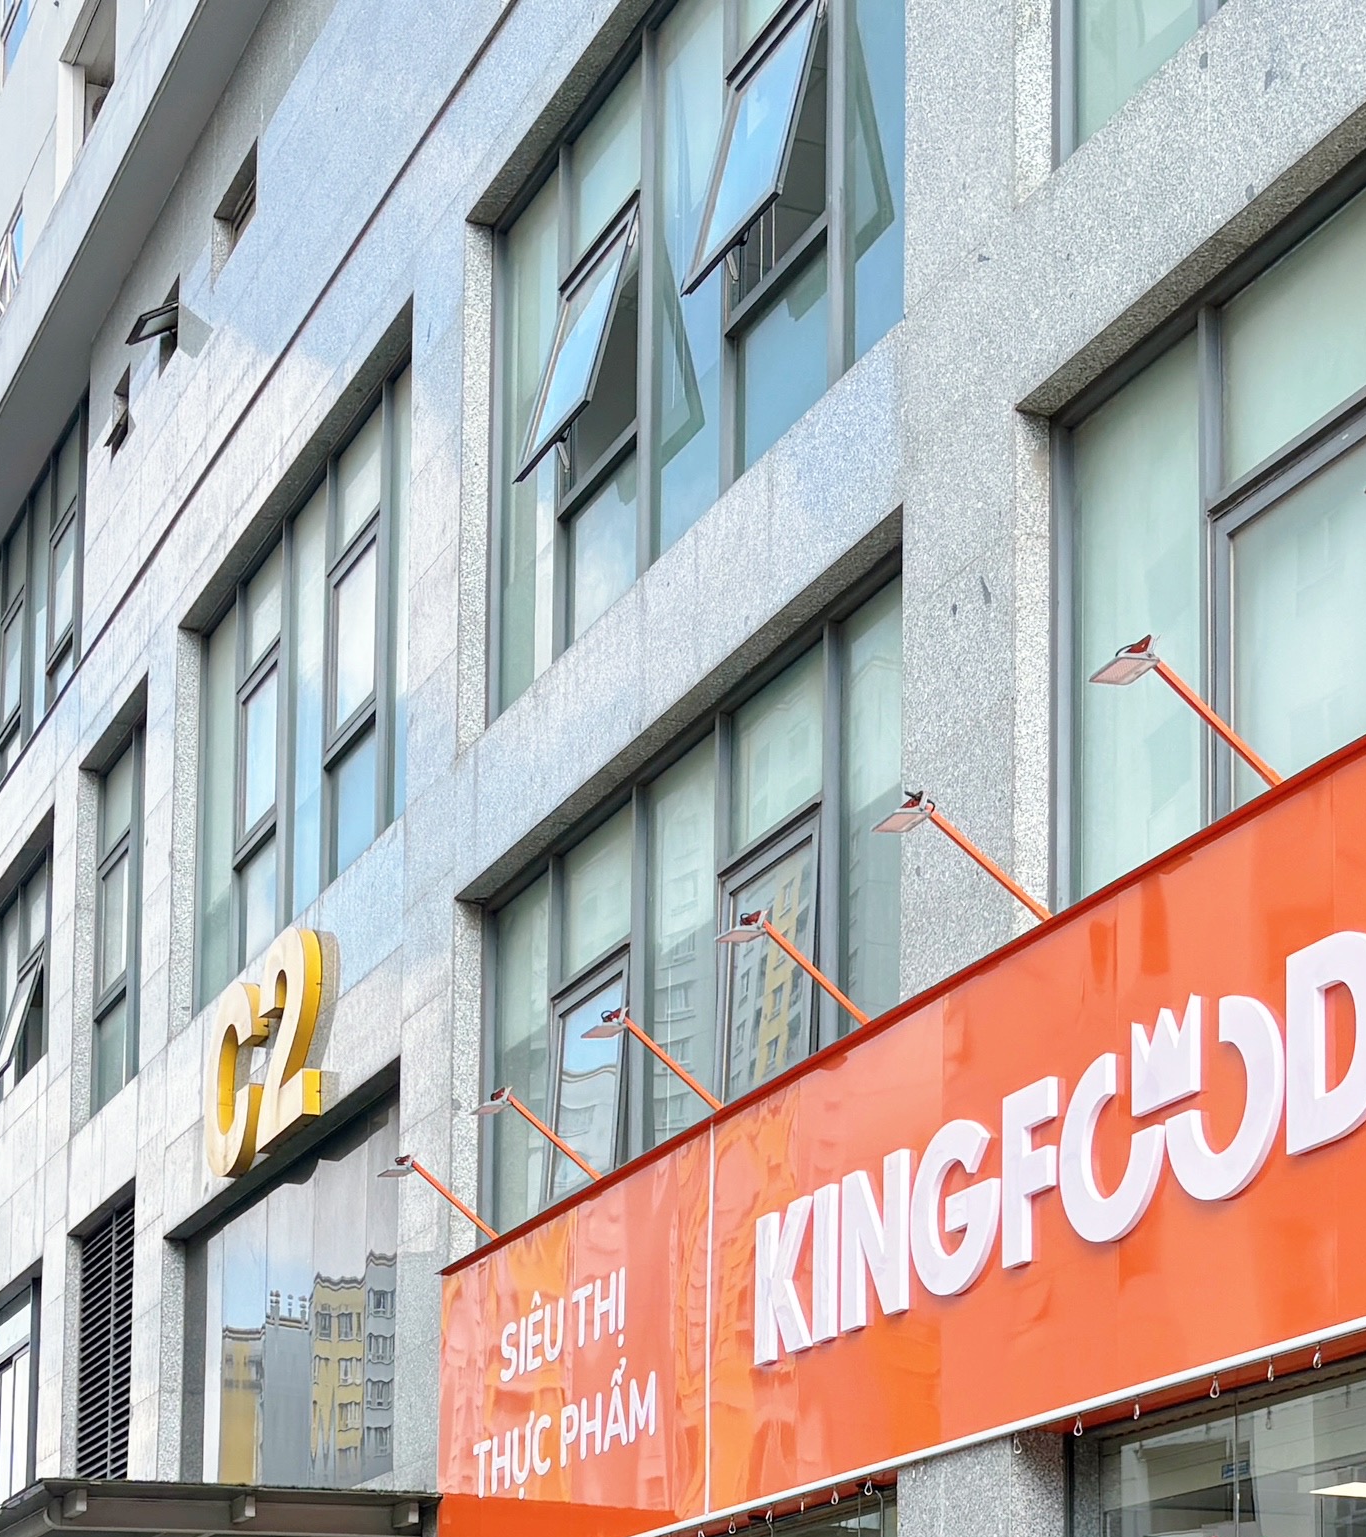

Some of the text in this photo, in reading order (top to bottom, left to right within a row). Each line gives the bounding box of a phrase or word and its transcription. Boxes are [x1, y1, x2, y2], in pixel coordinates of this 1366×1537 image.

[204, 928, 323, 1178] C2
[500, 1267, 626, 1382] SIÊU THỊ
[473, 1357, 656, 1500] THỰC PHẨM
